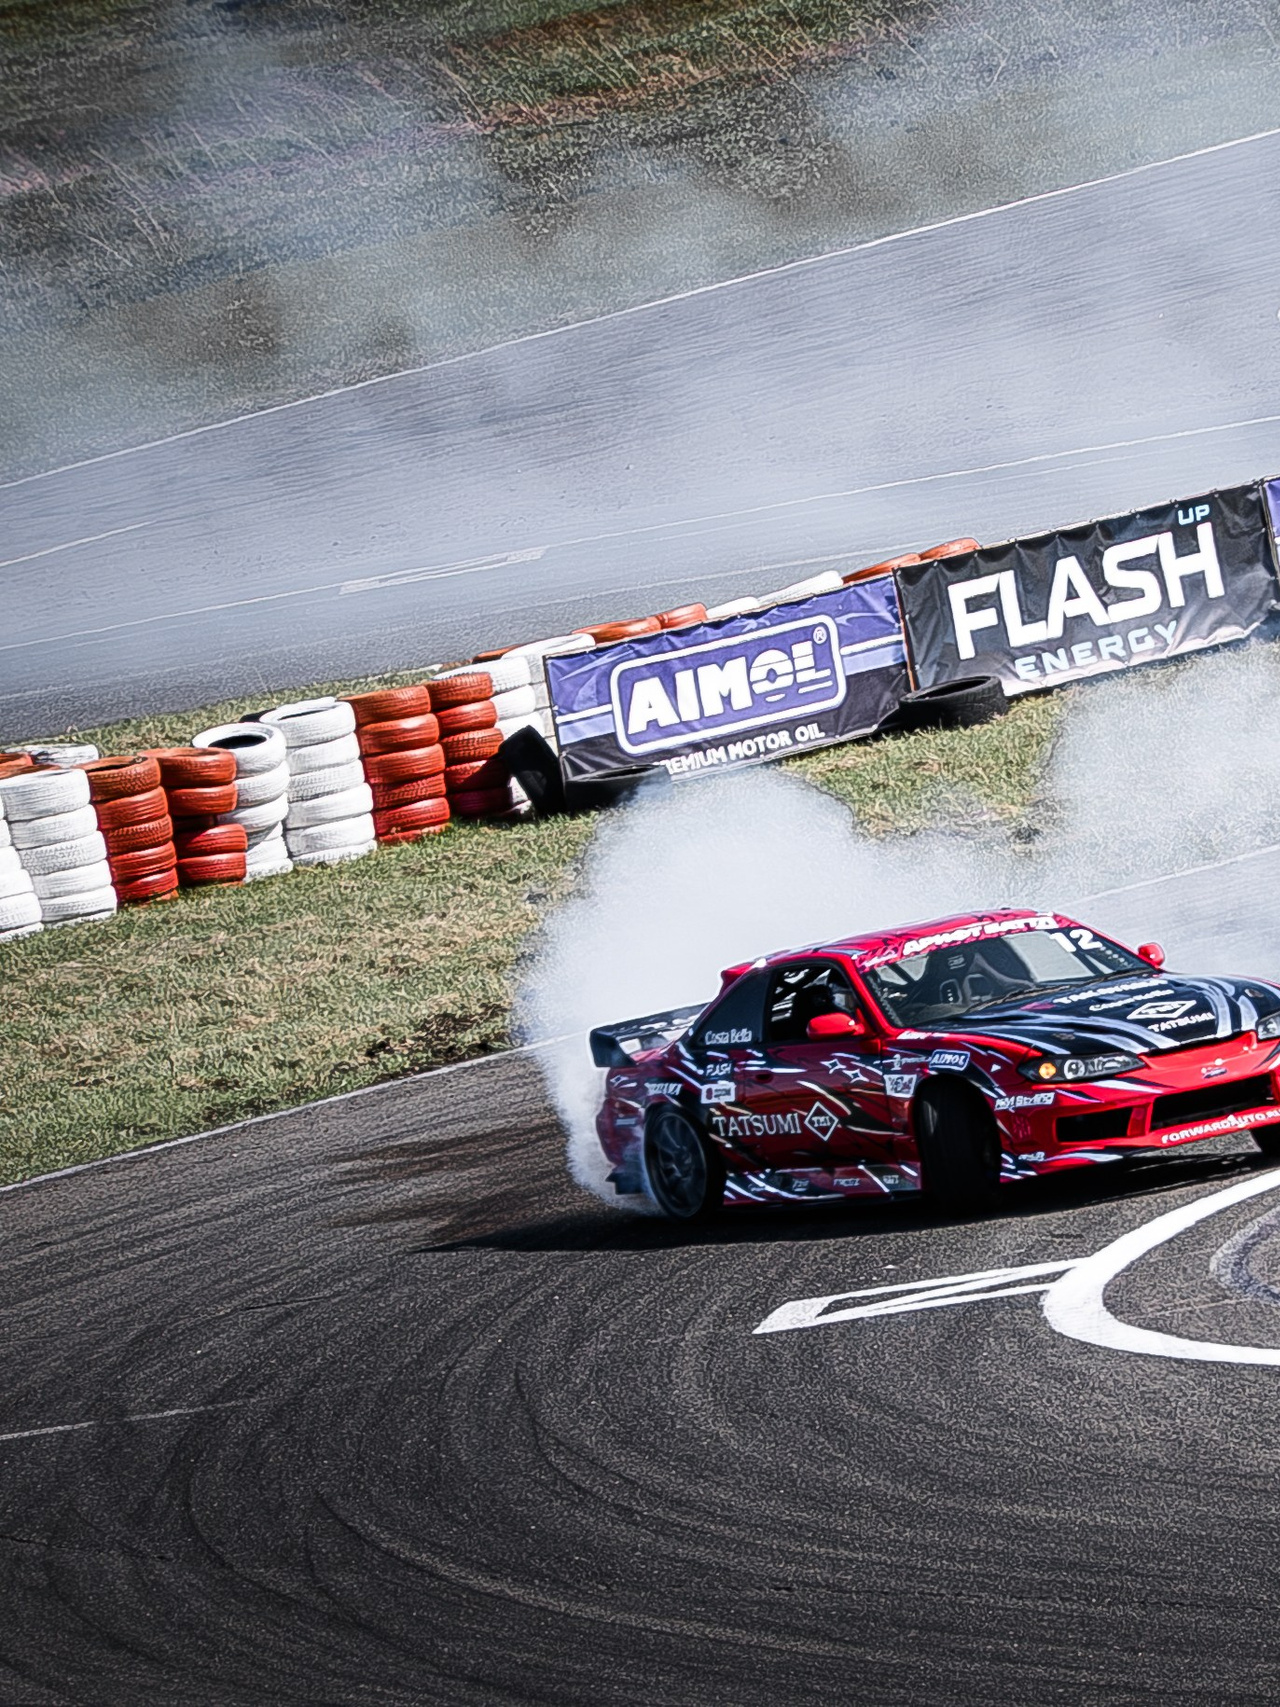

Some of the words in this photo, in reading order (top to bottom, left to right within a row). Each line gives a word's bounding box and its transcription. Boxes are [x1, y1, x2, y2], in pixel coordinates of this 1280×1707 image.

[1177, 504, 1211, 526] UP
[947, 521, 1226, 660] FLASH
[1013, 620, 1178, 680] ENERGY
[626, 639, 834, 735] AIMOL
[653, 746, 727, 775] REMIUM
[727, 730, 793, 760] MOTOR
[794, 722, 826, 742] OIL
[1050, 928, 1102, 953] 12
[1147, 1012, 1216, 1033] TATSUMI
[705, 1030, 730, 1046] Costa
[712, 1113, 802, 1137] TATSUMI
